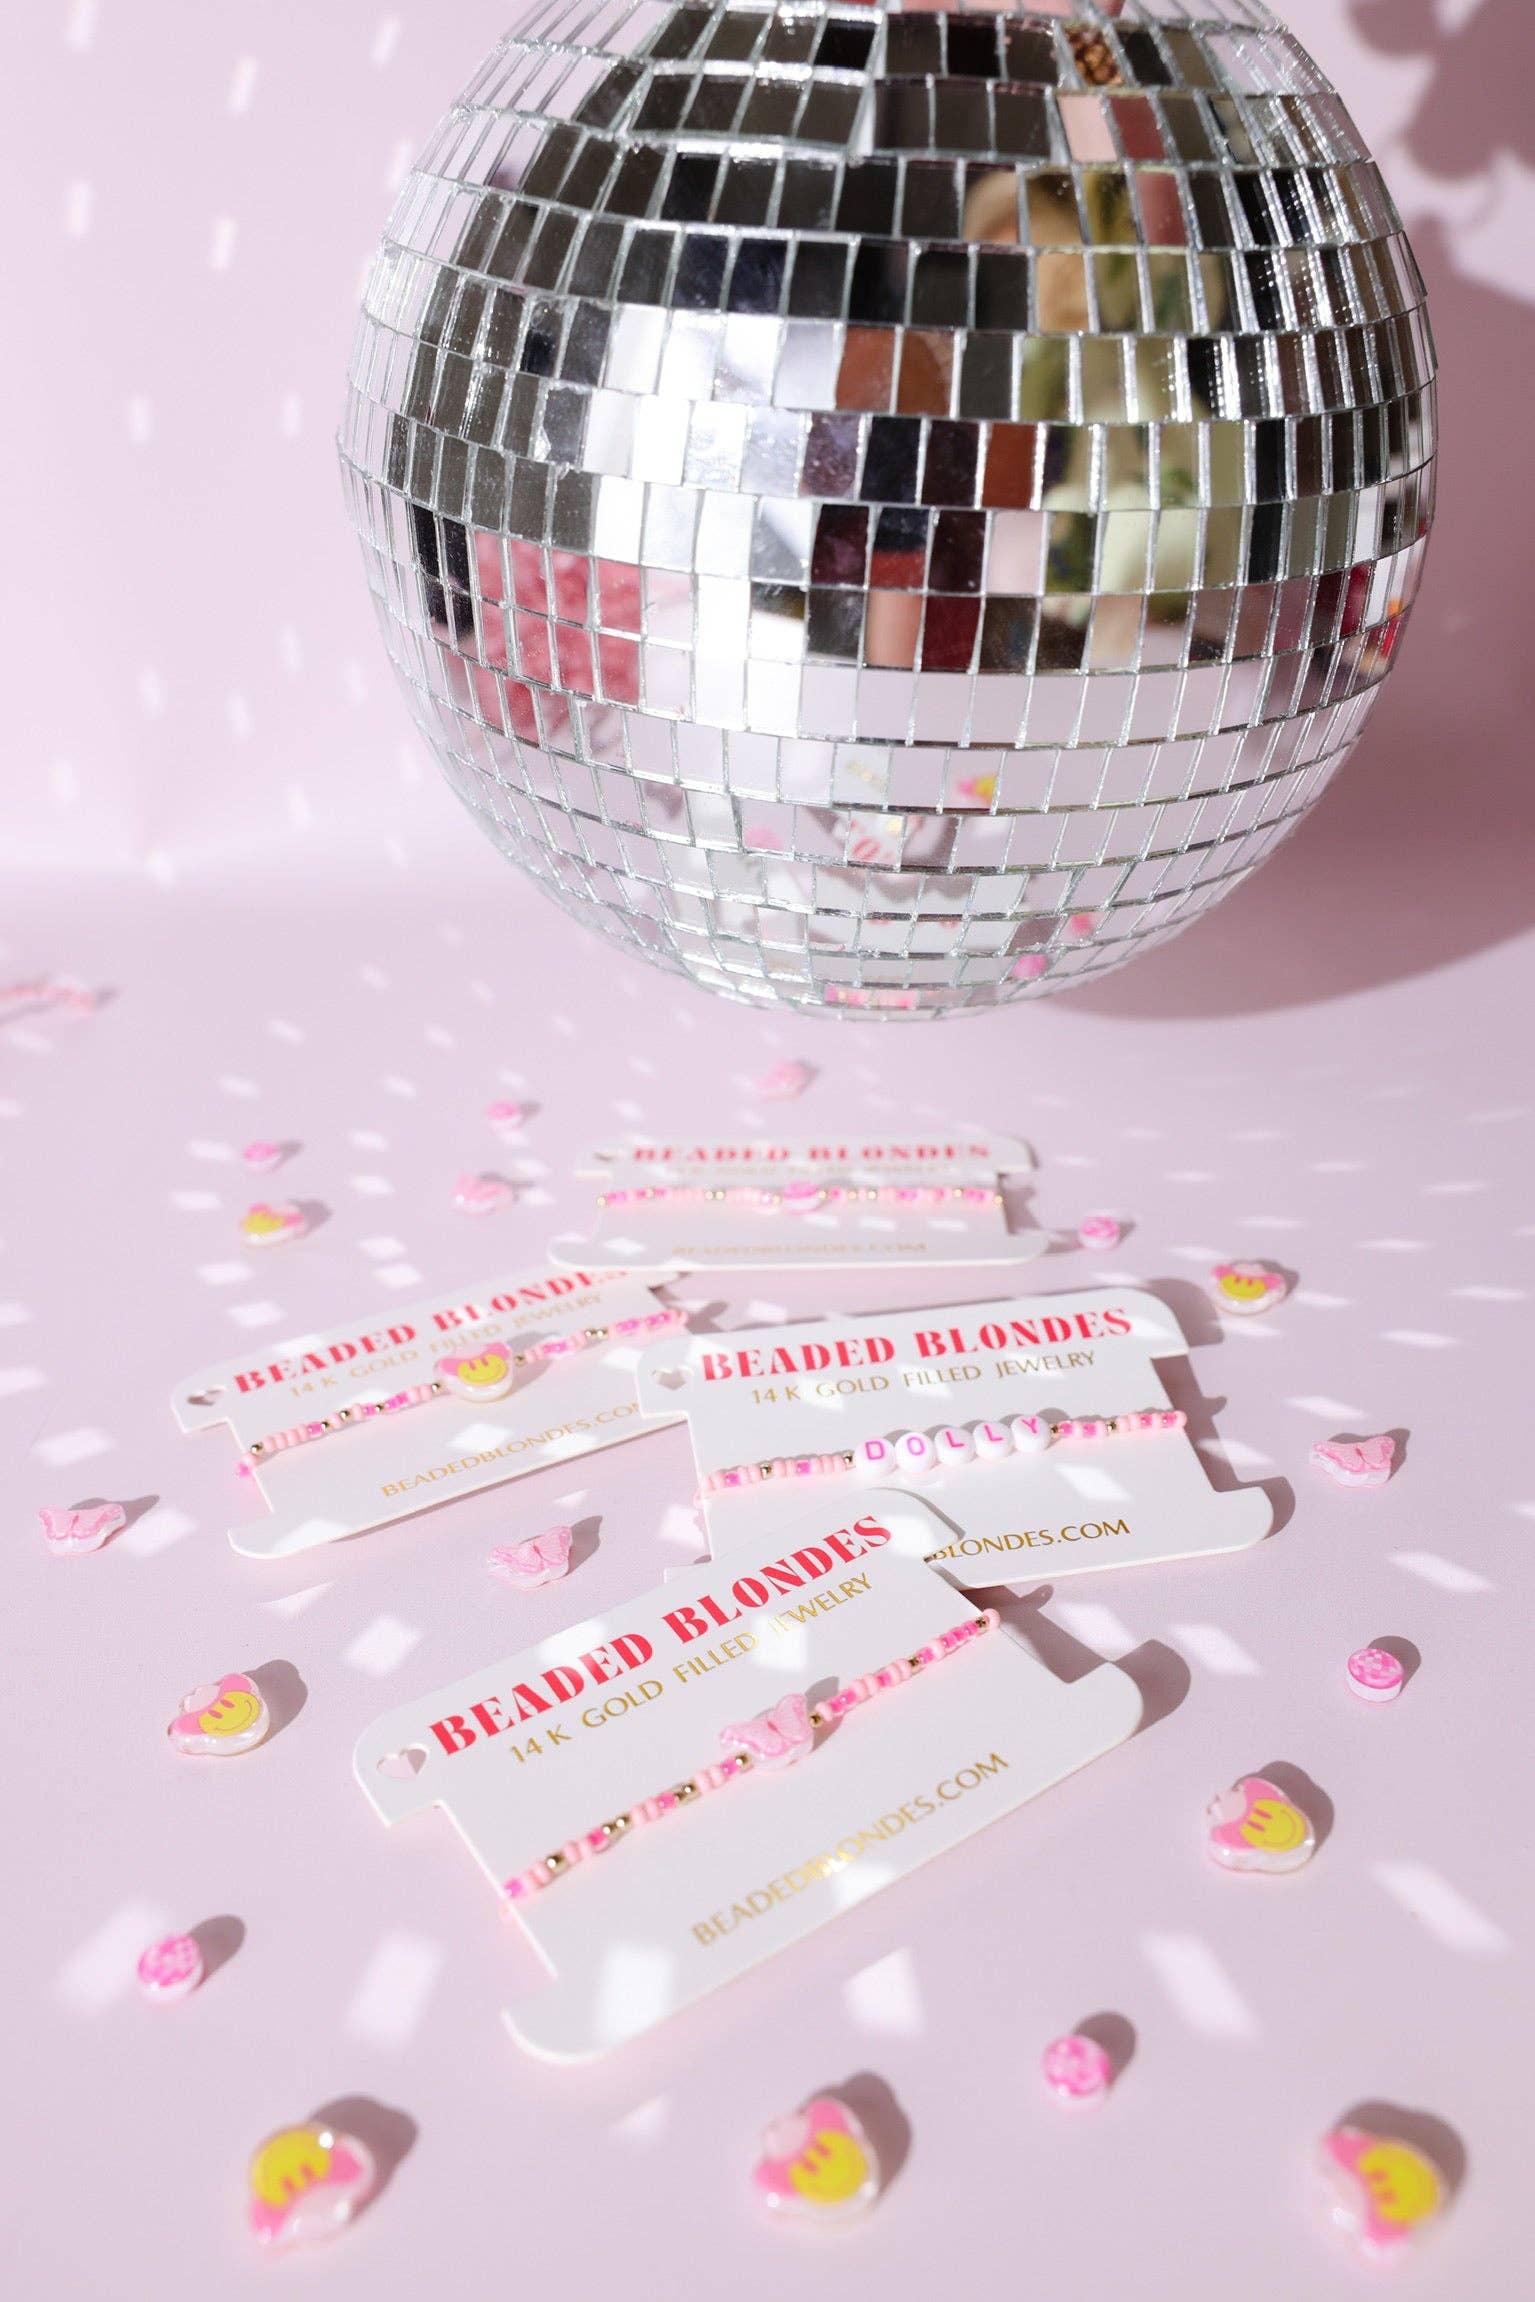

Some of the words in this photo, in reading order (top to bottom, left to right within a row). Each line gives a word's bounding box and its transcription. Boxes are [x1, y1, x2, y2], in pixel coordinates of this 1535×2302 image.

[634, 1144, 790, 1161] BEADED
[808, 1143, 991, 1162] BLONDES
[234, 1324, 416, 1393] BEADED
[350, 1349, 419, 1378] GOLD
[702, 1336, 895, 1382] BEADED
[915, 1307, 1132, 1358] BLONDES
[752, 1386, 778, 1405] 14
[783, 1384, 801, 1401] K
[816, 1375, 890, 1397] GOLD
[903, 1364, 982, 1388] FILLED
[995, 1349, 1095, 1379] JEWELRY
[865, 1417, 1038, 1461] DOLLY
[429, 1633, 655, 1756] BEADED
[662, 1515, 892, 1644] BLONDES
[509, 1737, 544, 1764] 14
[546, 1723, 573, 1746] K
[581, 1679, 665, 1729] GOLD
[672, 1631, 761, 1684] FILLED
[768, 1571, 873, 1637] JEWELRY
[690, 1752, 1011, 1947] BEADEDBLONDES.COM
